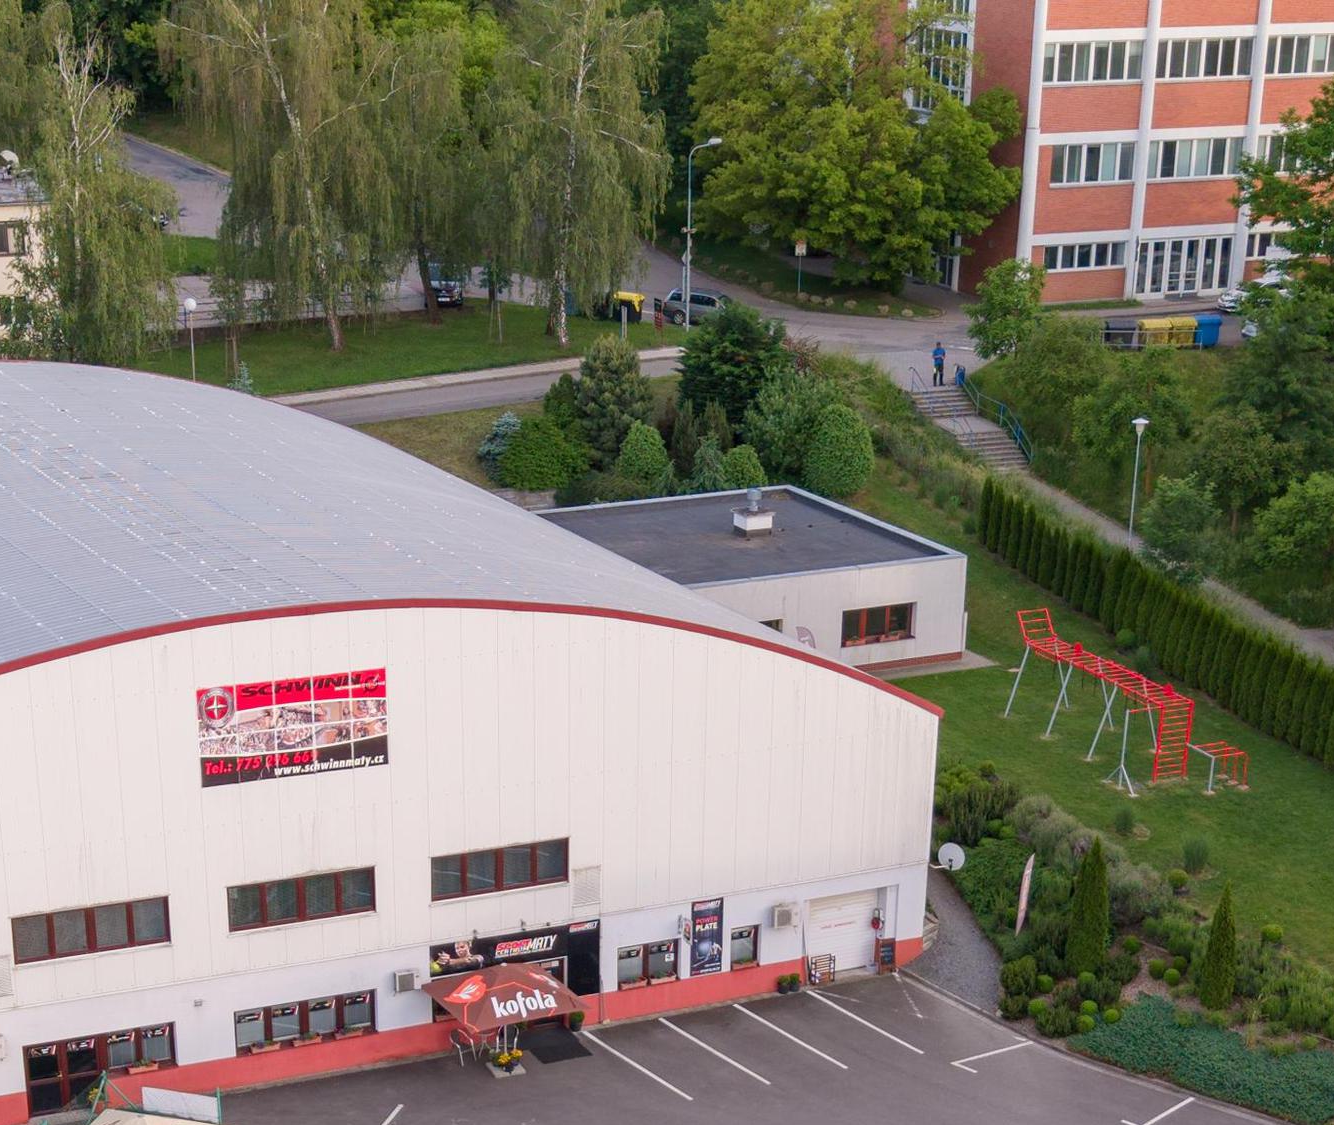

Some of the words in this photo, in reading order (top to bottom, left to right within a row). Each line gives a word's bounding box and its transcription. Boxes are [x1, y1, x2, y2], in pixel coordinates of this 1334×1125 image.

[241, 674, 362, 697] SCHWINN
[204, 760, 232, 775] Tel.:
[293, 750, 317, 763] 66
[274, 754, 385, 776] www.schwinnmaty.cz
[695, 921, 718, 932] PLATE
[490, 988, 558, 1018] kofola
